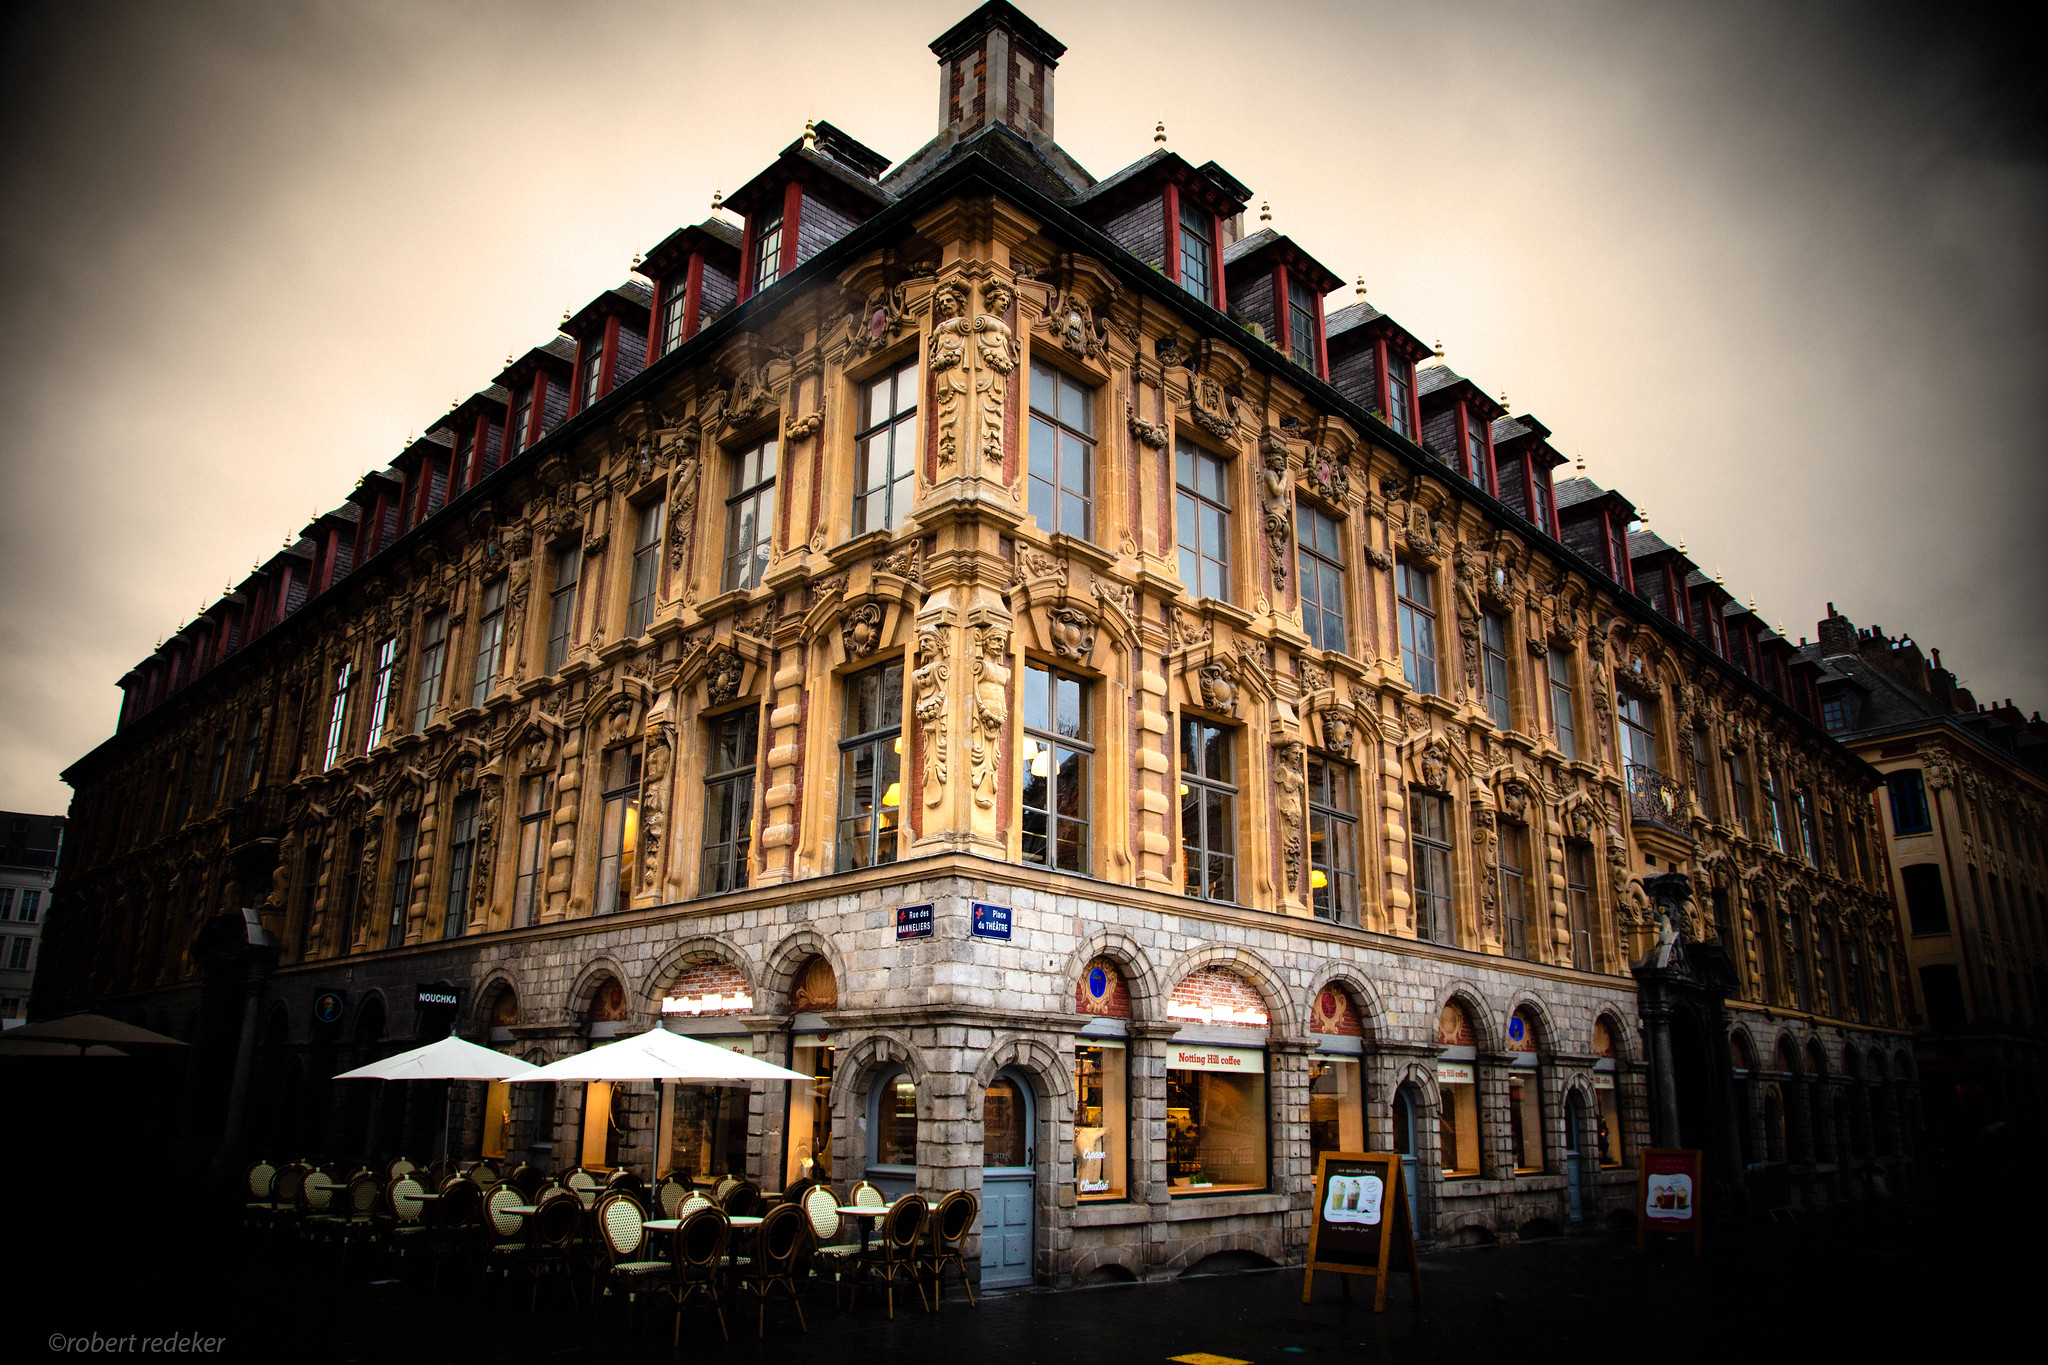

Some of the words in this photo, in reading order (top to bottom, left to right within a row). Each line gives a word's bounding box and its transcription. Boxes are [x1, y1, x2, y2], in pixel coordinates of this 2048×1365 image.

[908, 911, 919, 920] Rue
[920, 909, 930, 918] des
[992, 909, 1007, 920] Place
[897, 922, 931, 934] MANNELIERS
[977, 921, 985, 930] du
[985, 921, 1008, 933] THÉÂTRE
[419, 993, 457, 1004] NOUCHKA
[1178, 1052, 1206, 1066] Notting
[1207, 1054, 1220, 1064] Hill
[1220, 1055, 1241, 1066] coffee
[1083, 1148, 1106, 1161] Espace
[1080, 1179, 1109, 1192] Climatisé
